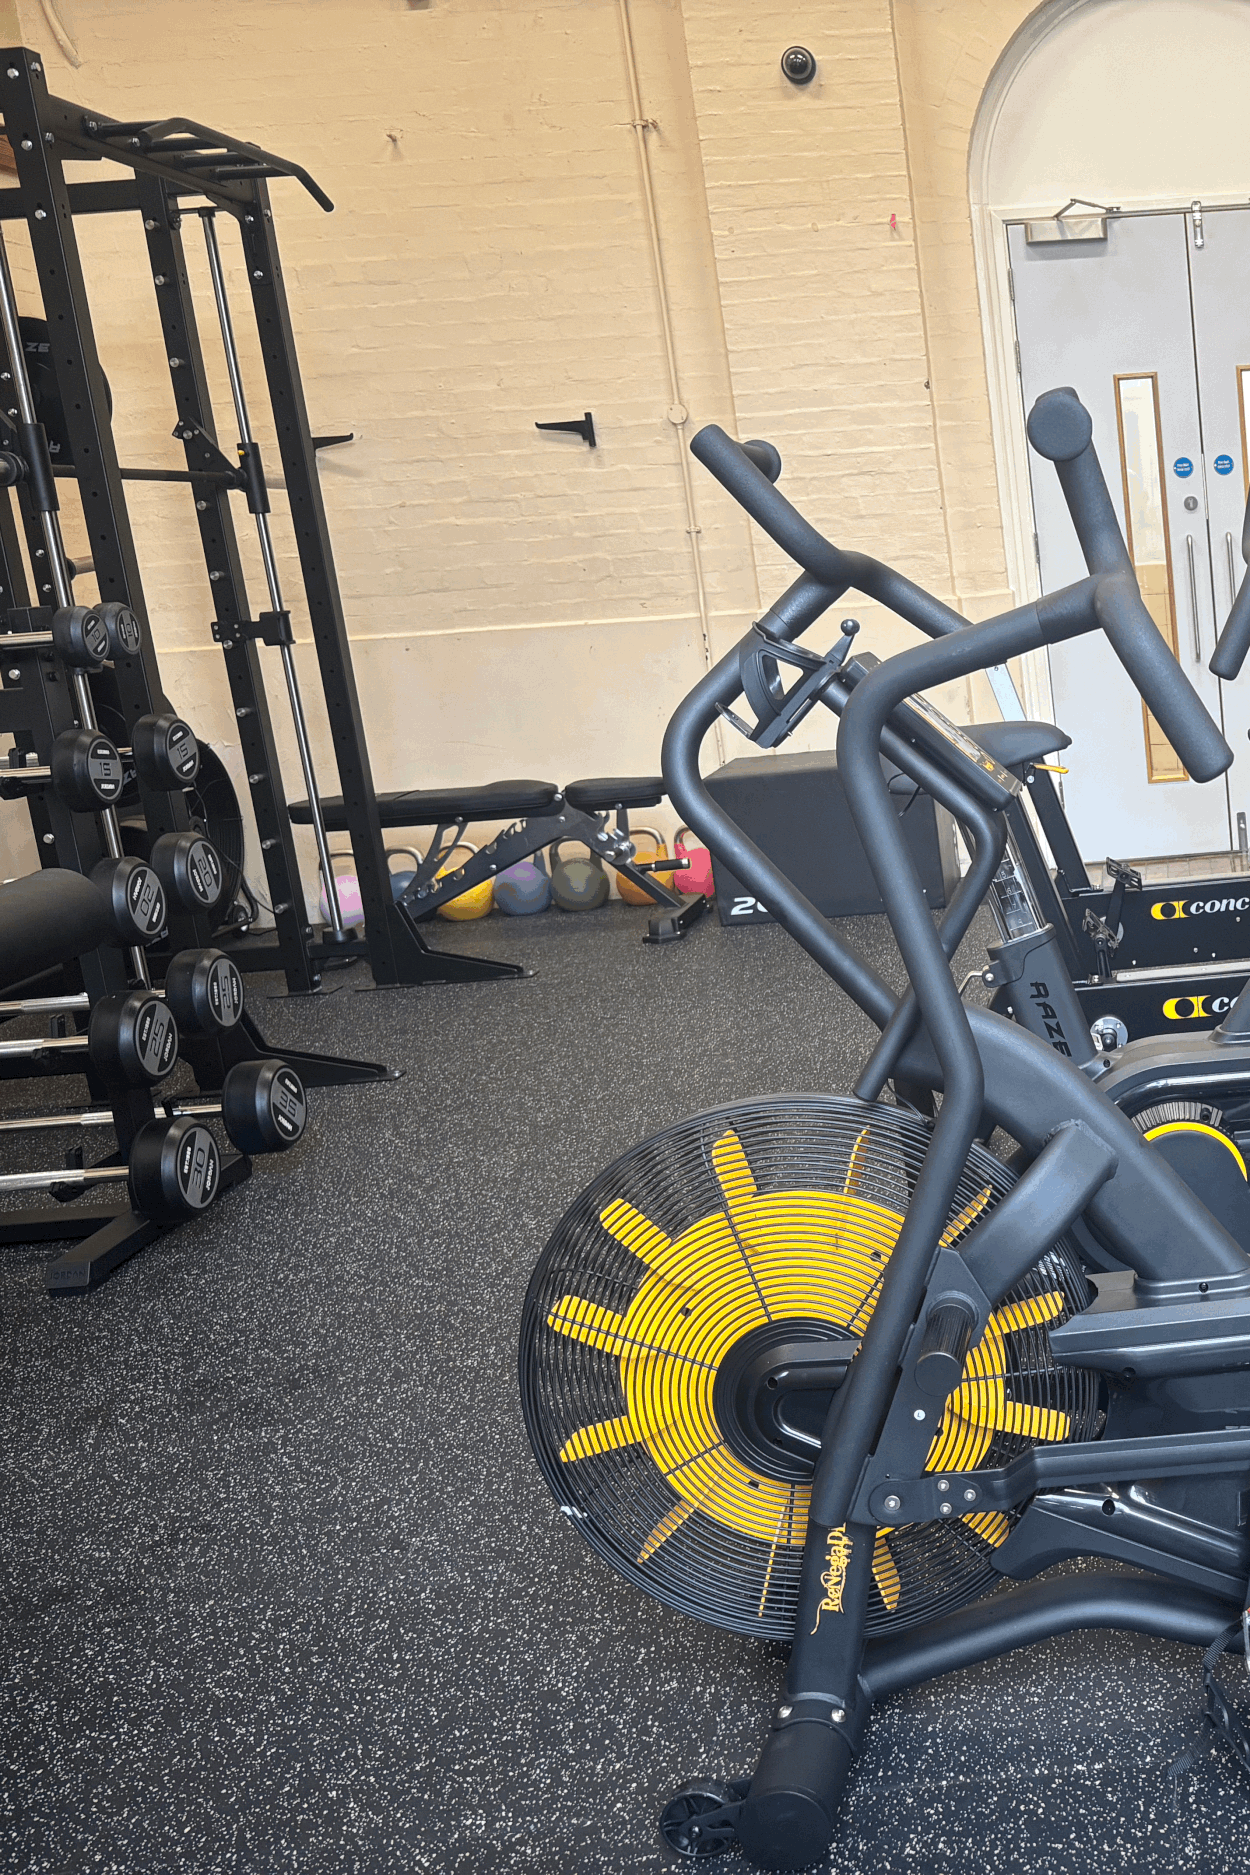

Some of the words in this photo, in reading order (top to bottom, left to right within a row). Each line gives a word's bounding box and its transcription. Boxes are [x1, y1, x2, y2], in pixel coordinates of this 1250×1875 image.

[26, 342, 50, 352] ZE
[177, 742, 189, 760] 15
[100, 762, 112, 776] 15
[198, 856, 212, 887] 20
[140, 884, 155, 917] 20
[221, 976, 231, 1009] 25
[150, 1019, 164, 1057] 25
[163, 1033, 173, 1061] JORDAN
[279, 1090, 297, 1117] 35
[192, 1147, 206, 1189] 30
[205, 1159, 214, 1191] JORDAN
